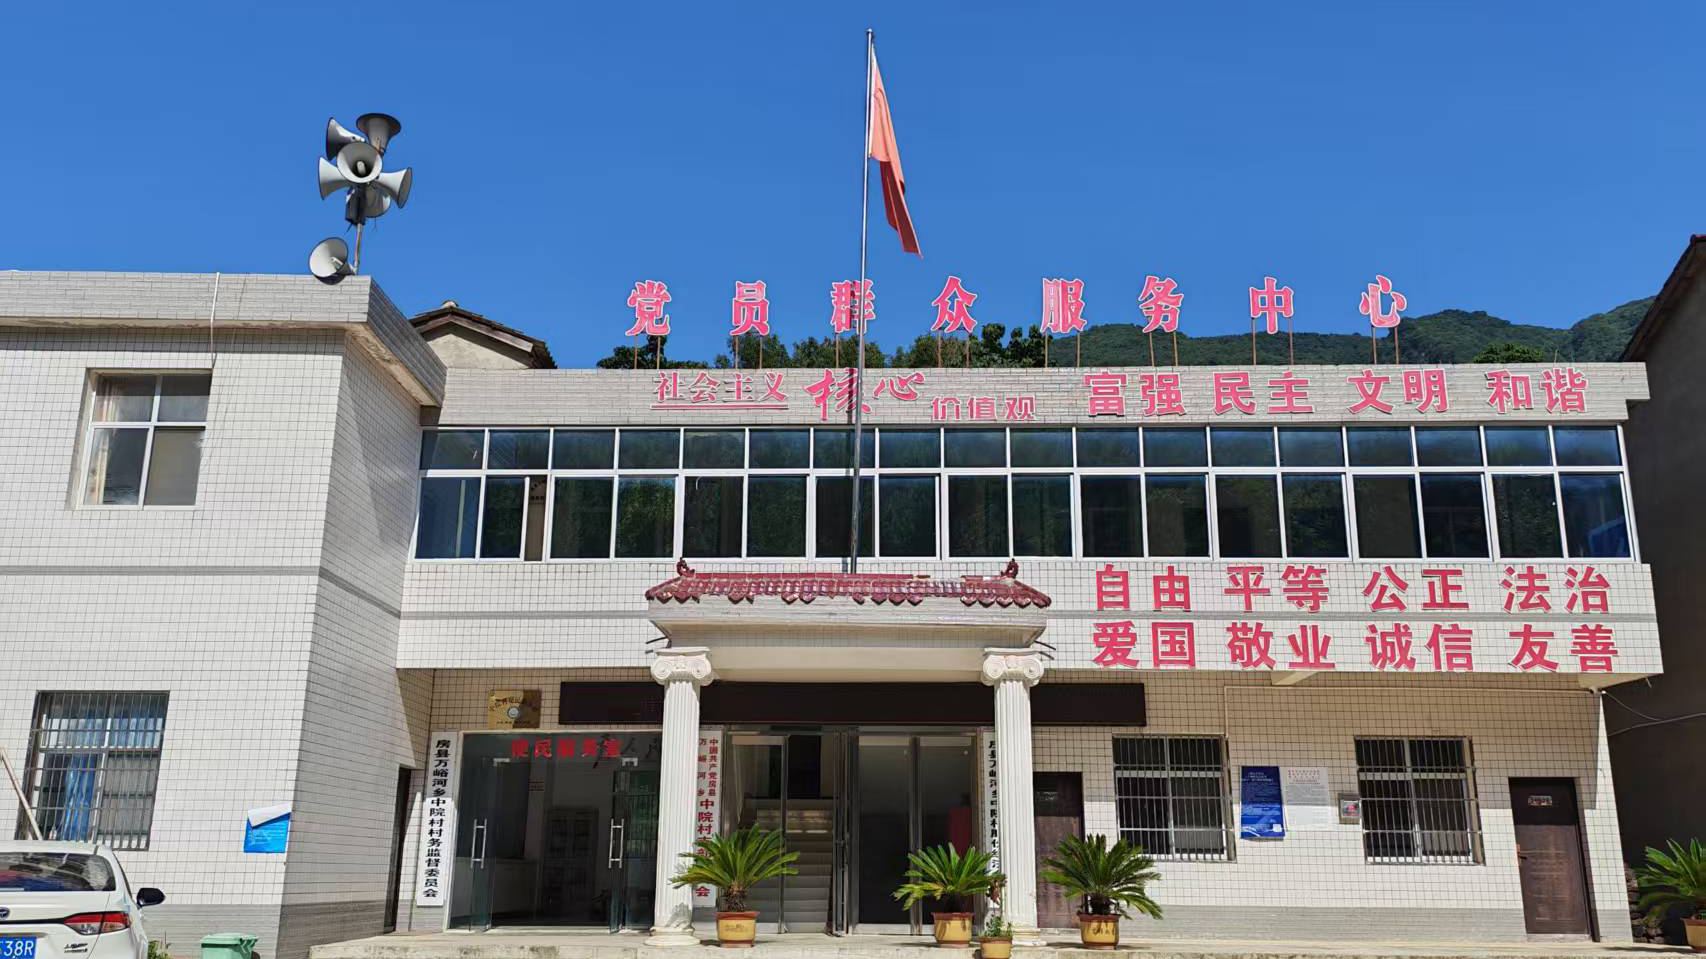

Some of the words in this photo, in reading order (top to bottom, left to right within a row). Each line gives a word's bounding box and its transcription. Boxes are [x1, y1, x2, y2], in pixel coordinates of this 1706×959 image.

[624, 274, 1408, 337] 党员群众服务中心
[654, 369, 788, 403] 社会主义
[804, 367, 926, 422] 核心
[931, 395, 1036, 423] 价值观
[1083, 371, 1187, 418] 富强
[1212, 371, 1316, 415] 民主
[1347, 368, 1451, 415] 文明
[1486, 366, 1591, 414] 和谐
[1095, 562, 1193, 613] 自由
[1223, 562, 1332, 614] 平等
[1361, 564, 1471, 614] 公正
[1499, 565, 1612, 615] 法治
[1091, 619, 1197, 670] 爱国
[1226, 620, 1336, 672] 敬业
[1364, 621, 1474, 674] 诚信
[1509, 622, 1619, 675] 友善
[707, 738, 719, 797] 中国共产党房县
[422, 738, 452, 899] 房县万峪河乡中院村村务监督委员会
